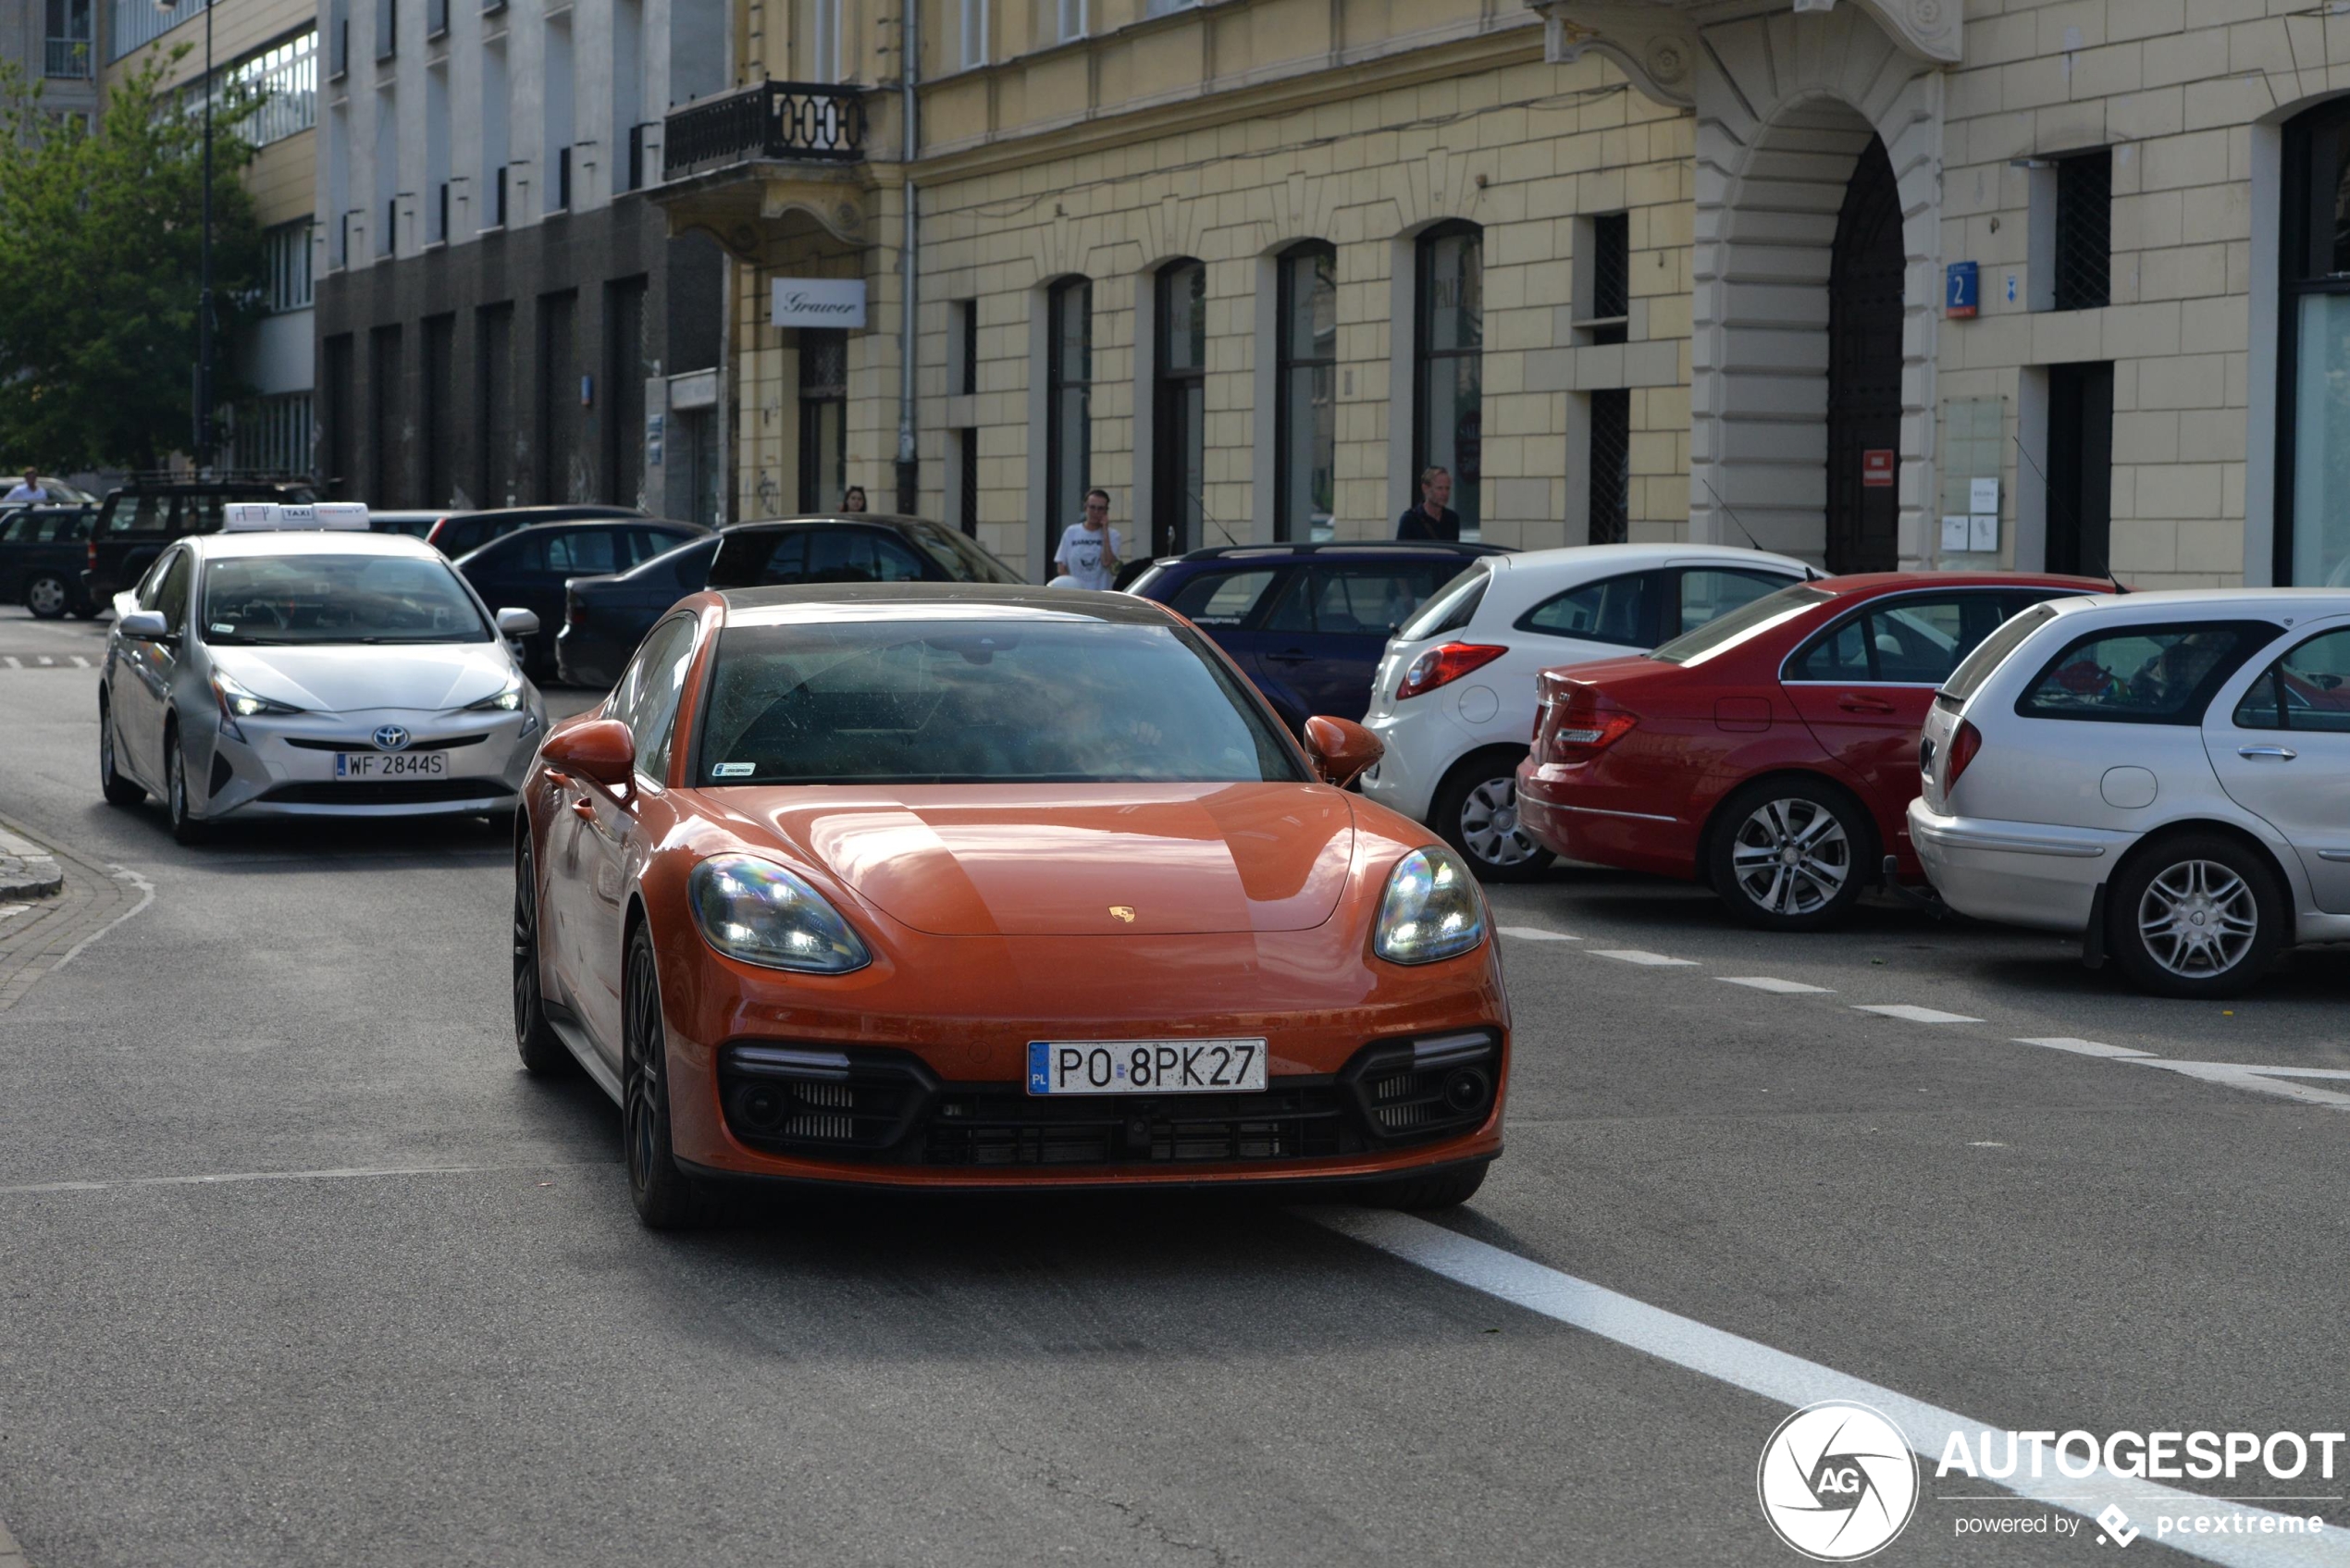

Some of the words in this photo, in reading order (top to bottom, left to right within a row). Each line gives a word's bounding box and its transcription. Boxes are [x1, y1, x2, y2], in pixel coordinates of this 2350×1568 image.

[1954, 275, 1964, 304] 2
[784, 291, 857, 315] Grawer
[287, 509, 310, 517] TAXI
[350, 756, 374, 775] WF
[382, 755, 442, 774] 2844S
[1059, 1048, 1112, 1088] PO
[1130, 1045, 1255, 1087] 8PK27
[1033, 1074, 1046, 1085] PL
